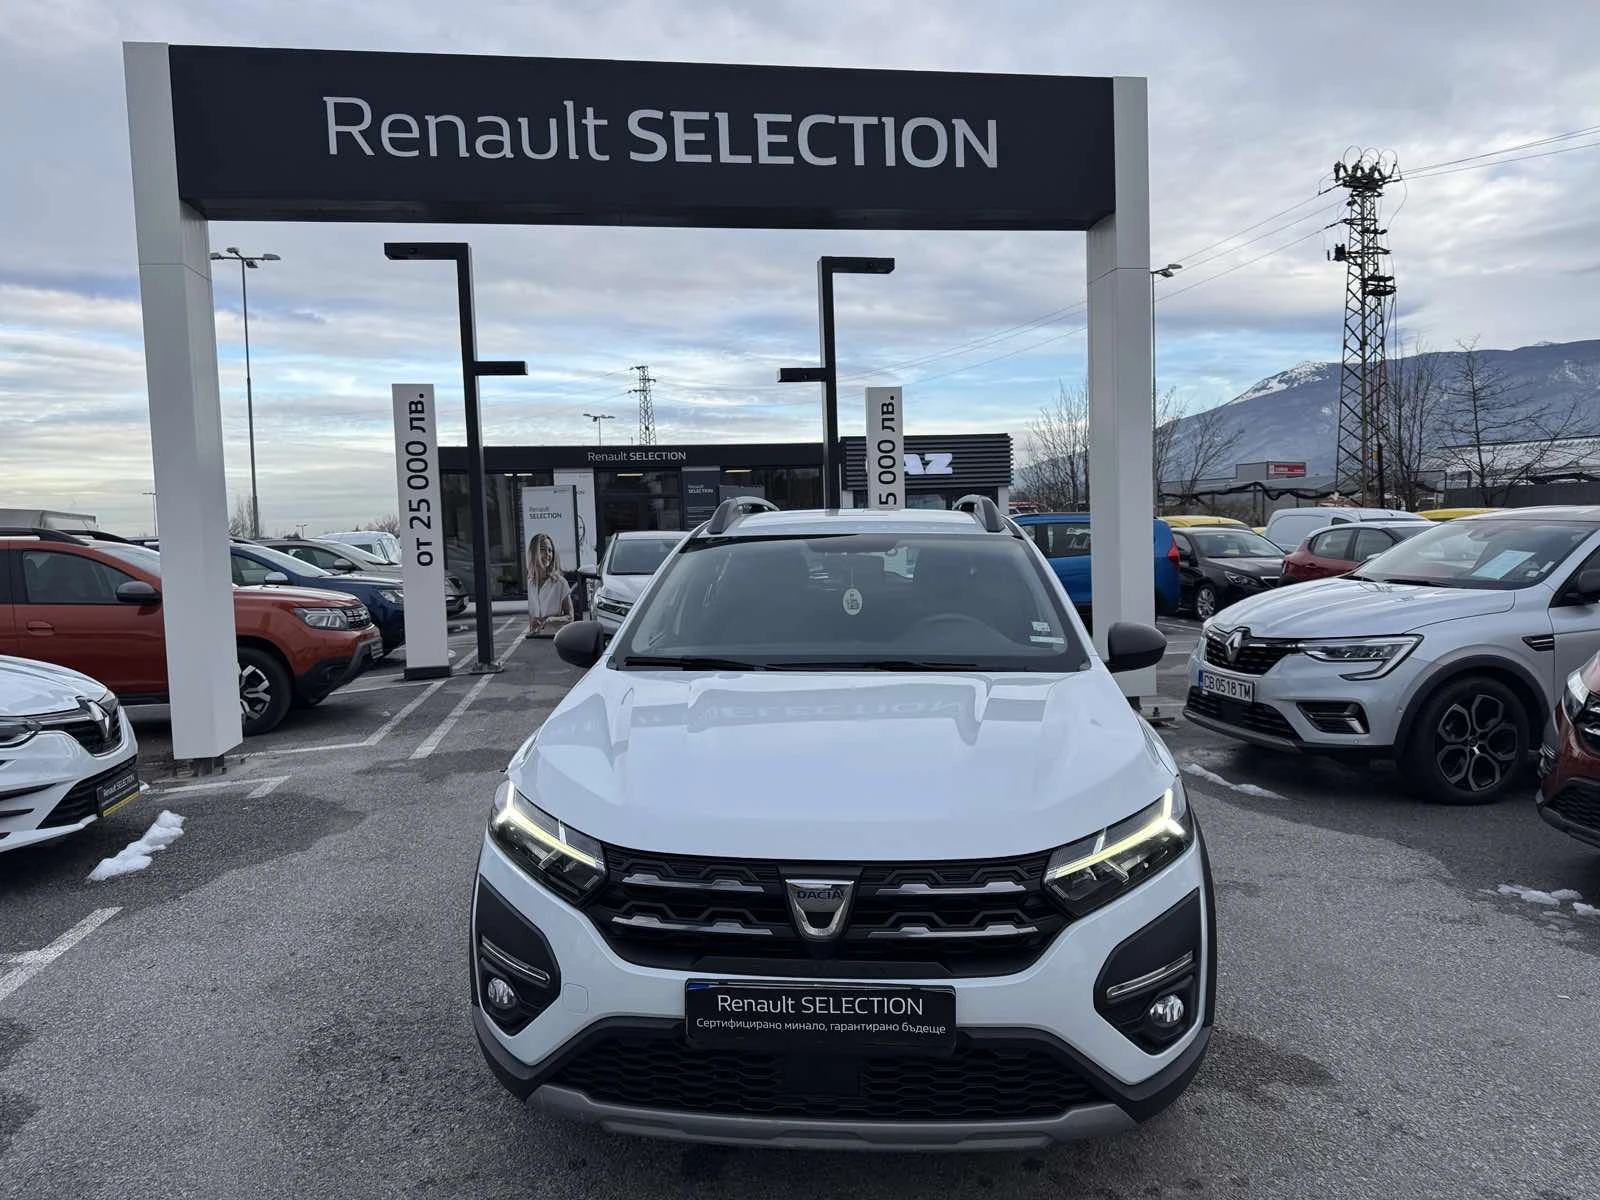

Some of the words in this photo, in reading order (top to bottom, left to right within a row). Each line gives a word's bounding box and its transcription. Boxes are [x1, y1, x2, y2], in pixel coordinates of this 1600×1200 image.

[323, 96, 609, 161] Renault
[627, 108, 998, 169] SELECTION
[405, 440, 429, 490] 000
[587, 451, 628, 462] Renault
[629, 451, 686, 461] SELECTION
[877, 439, 897, 485] 000
[409, 498, 432, 530] 25
[528, 512, 562, 520] SELECTION
[796, 888, 844, 900] DACIA
[717, 994, 795, 1014] Renault
[801, 996, 923, 1016] SELECTION
[696, 1017, 782, 1030] Сертифицирано
[784, 1021, 827, 1032] минало,
[829, 1021, 900, 1033] гарантирано
[901, 1021, 946, 1034] бъдеще
